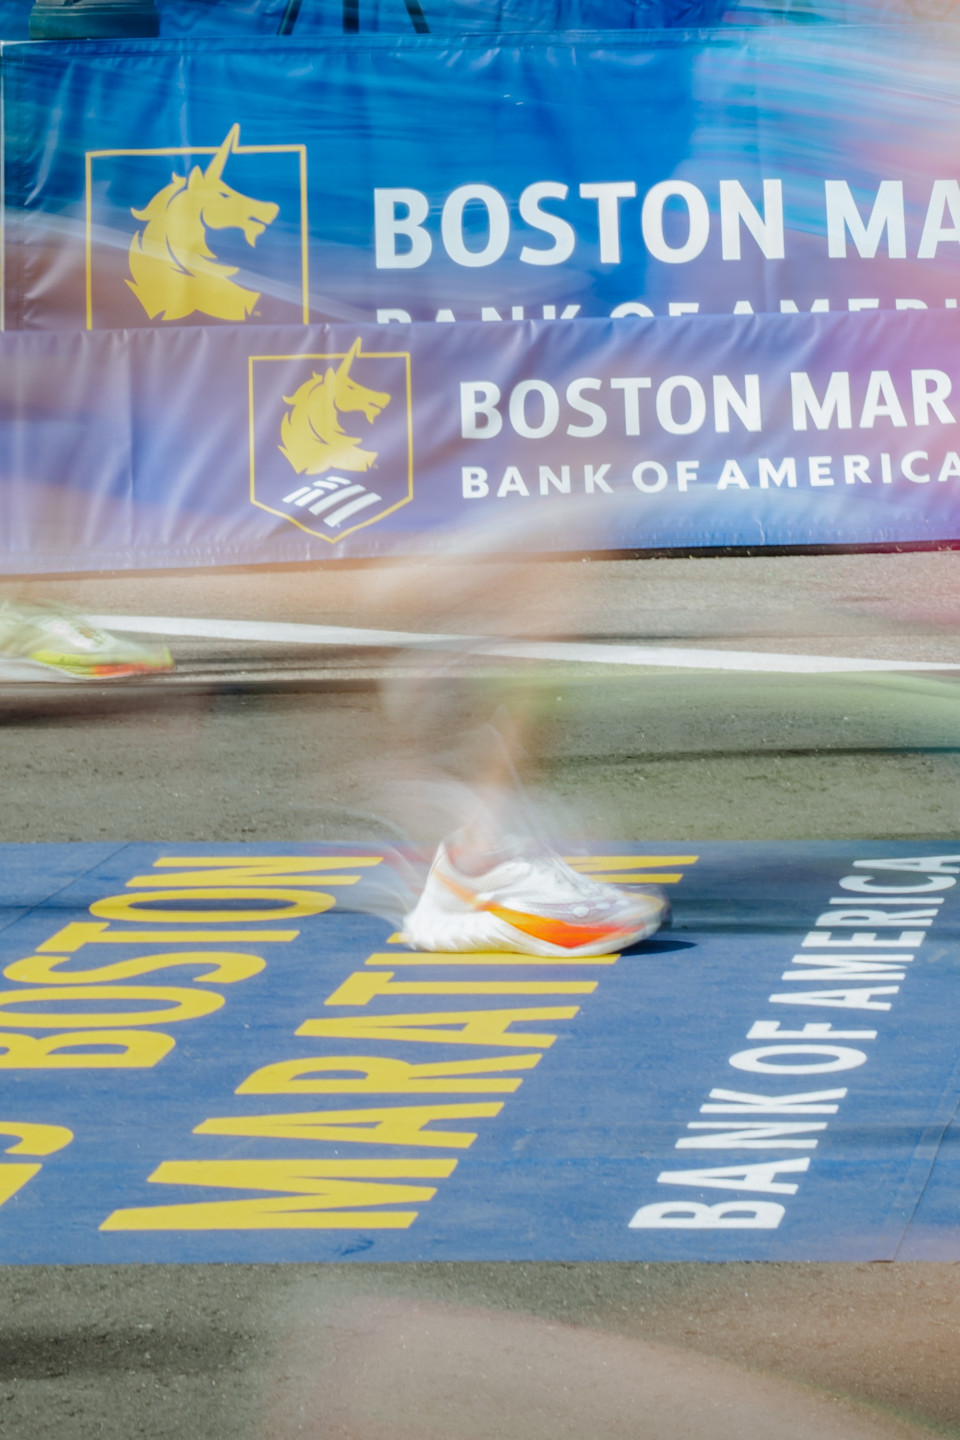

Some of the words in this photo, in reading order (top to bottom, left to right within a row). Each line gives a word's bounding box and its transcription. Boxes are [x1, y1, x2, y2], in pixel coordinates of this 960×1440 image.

[374, 180, 785, 269] BOSTON
[460, 374, 762, 439] BOSTON
[461, 463, 614, 499] BANK
[632, 461, 700, 493] OF
[0, 857, 384, 1068] BOSTON
[98, 856, 699, 1231] MARATN
[729, 1020, 878, 1075] OF
[628, 1087, 848, 1228] BANK
